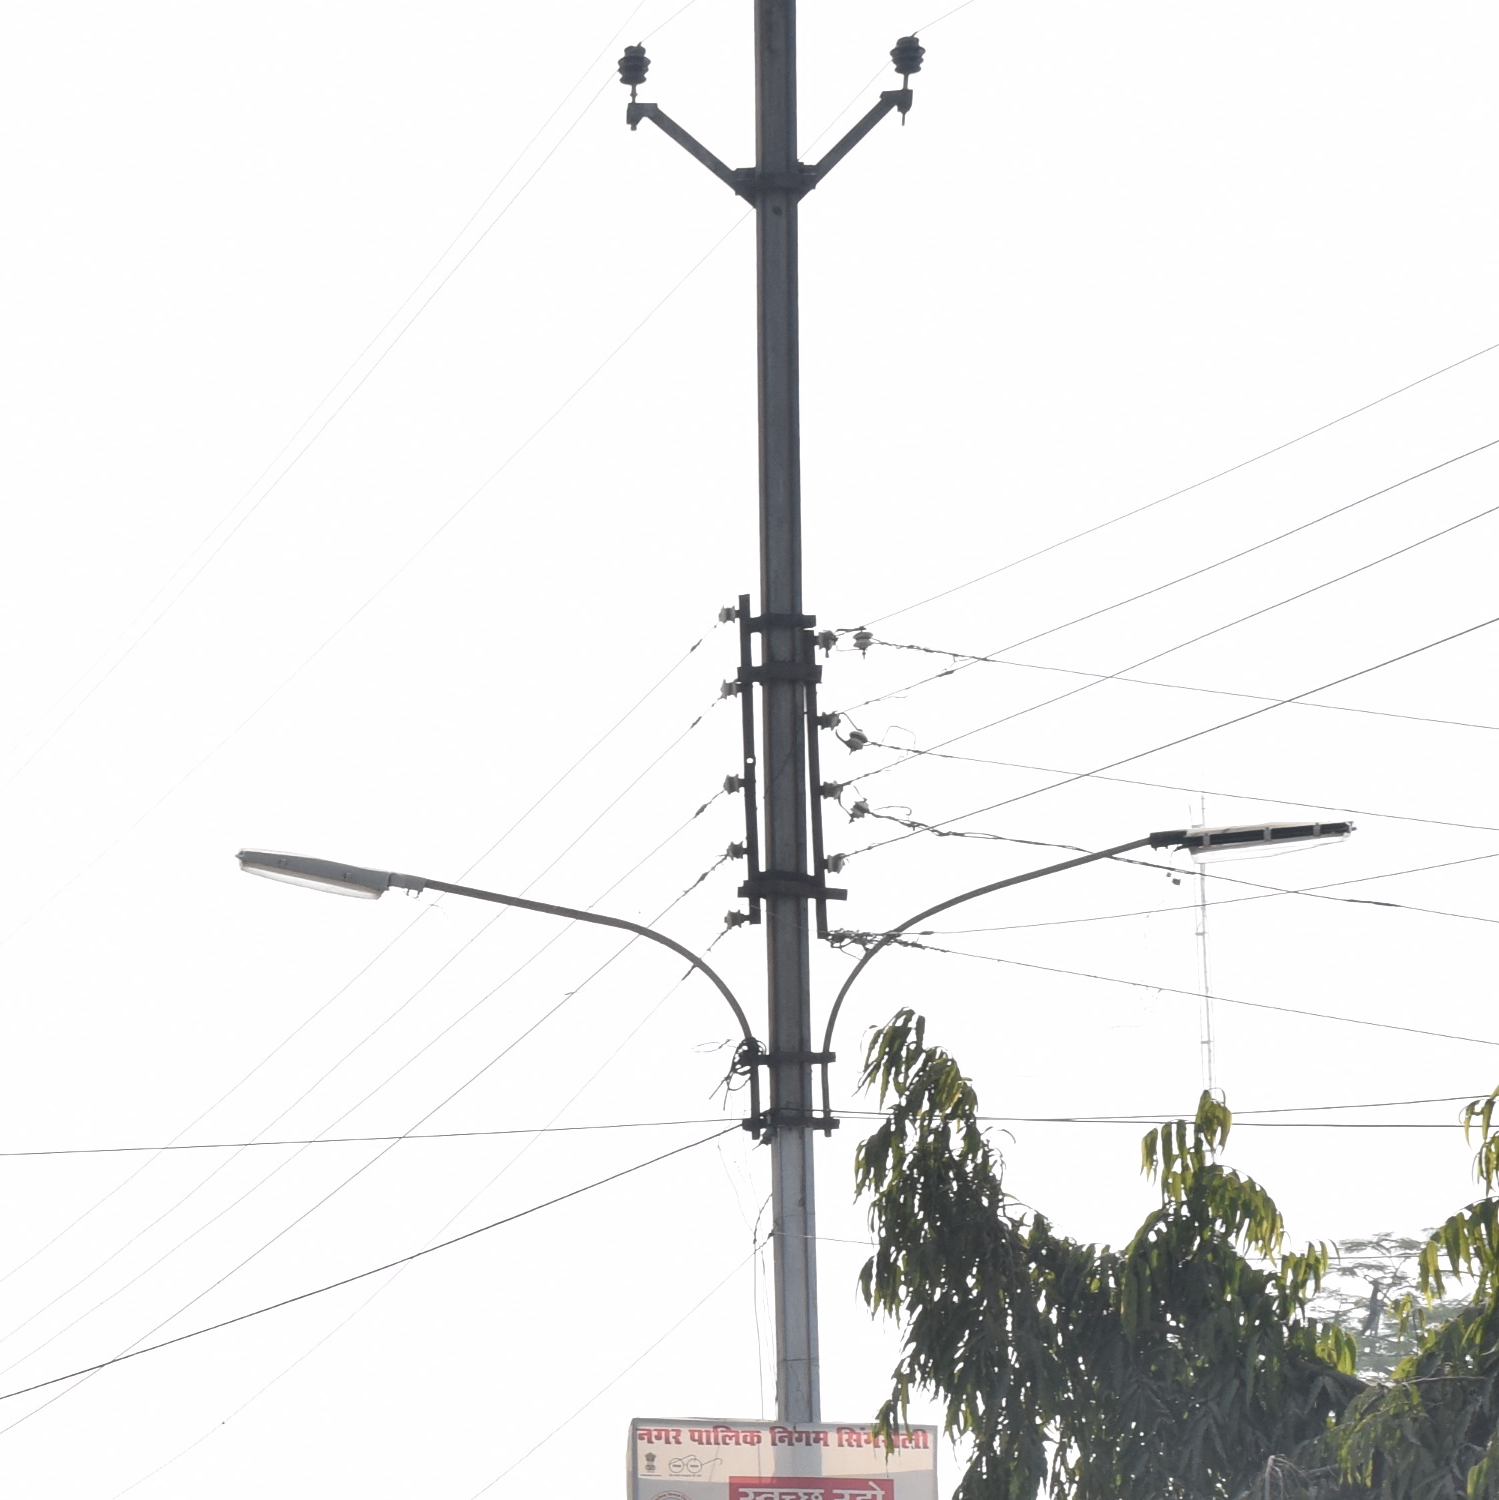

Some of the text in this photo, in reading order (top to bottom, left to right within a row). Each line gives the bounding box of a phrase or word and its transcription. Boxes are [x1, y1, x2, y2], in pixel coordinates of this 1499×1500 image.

[636, 1427, 683, 1445] नगर
[688, 1425, 763, 1446] पालिक
[769, 1425, 830, 1447] निगम
